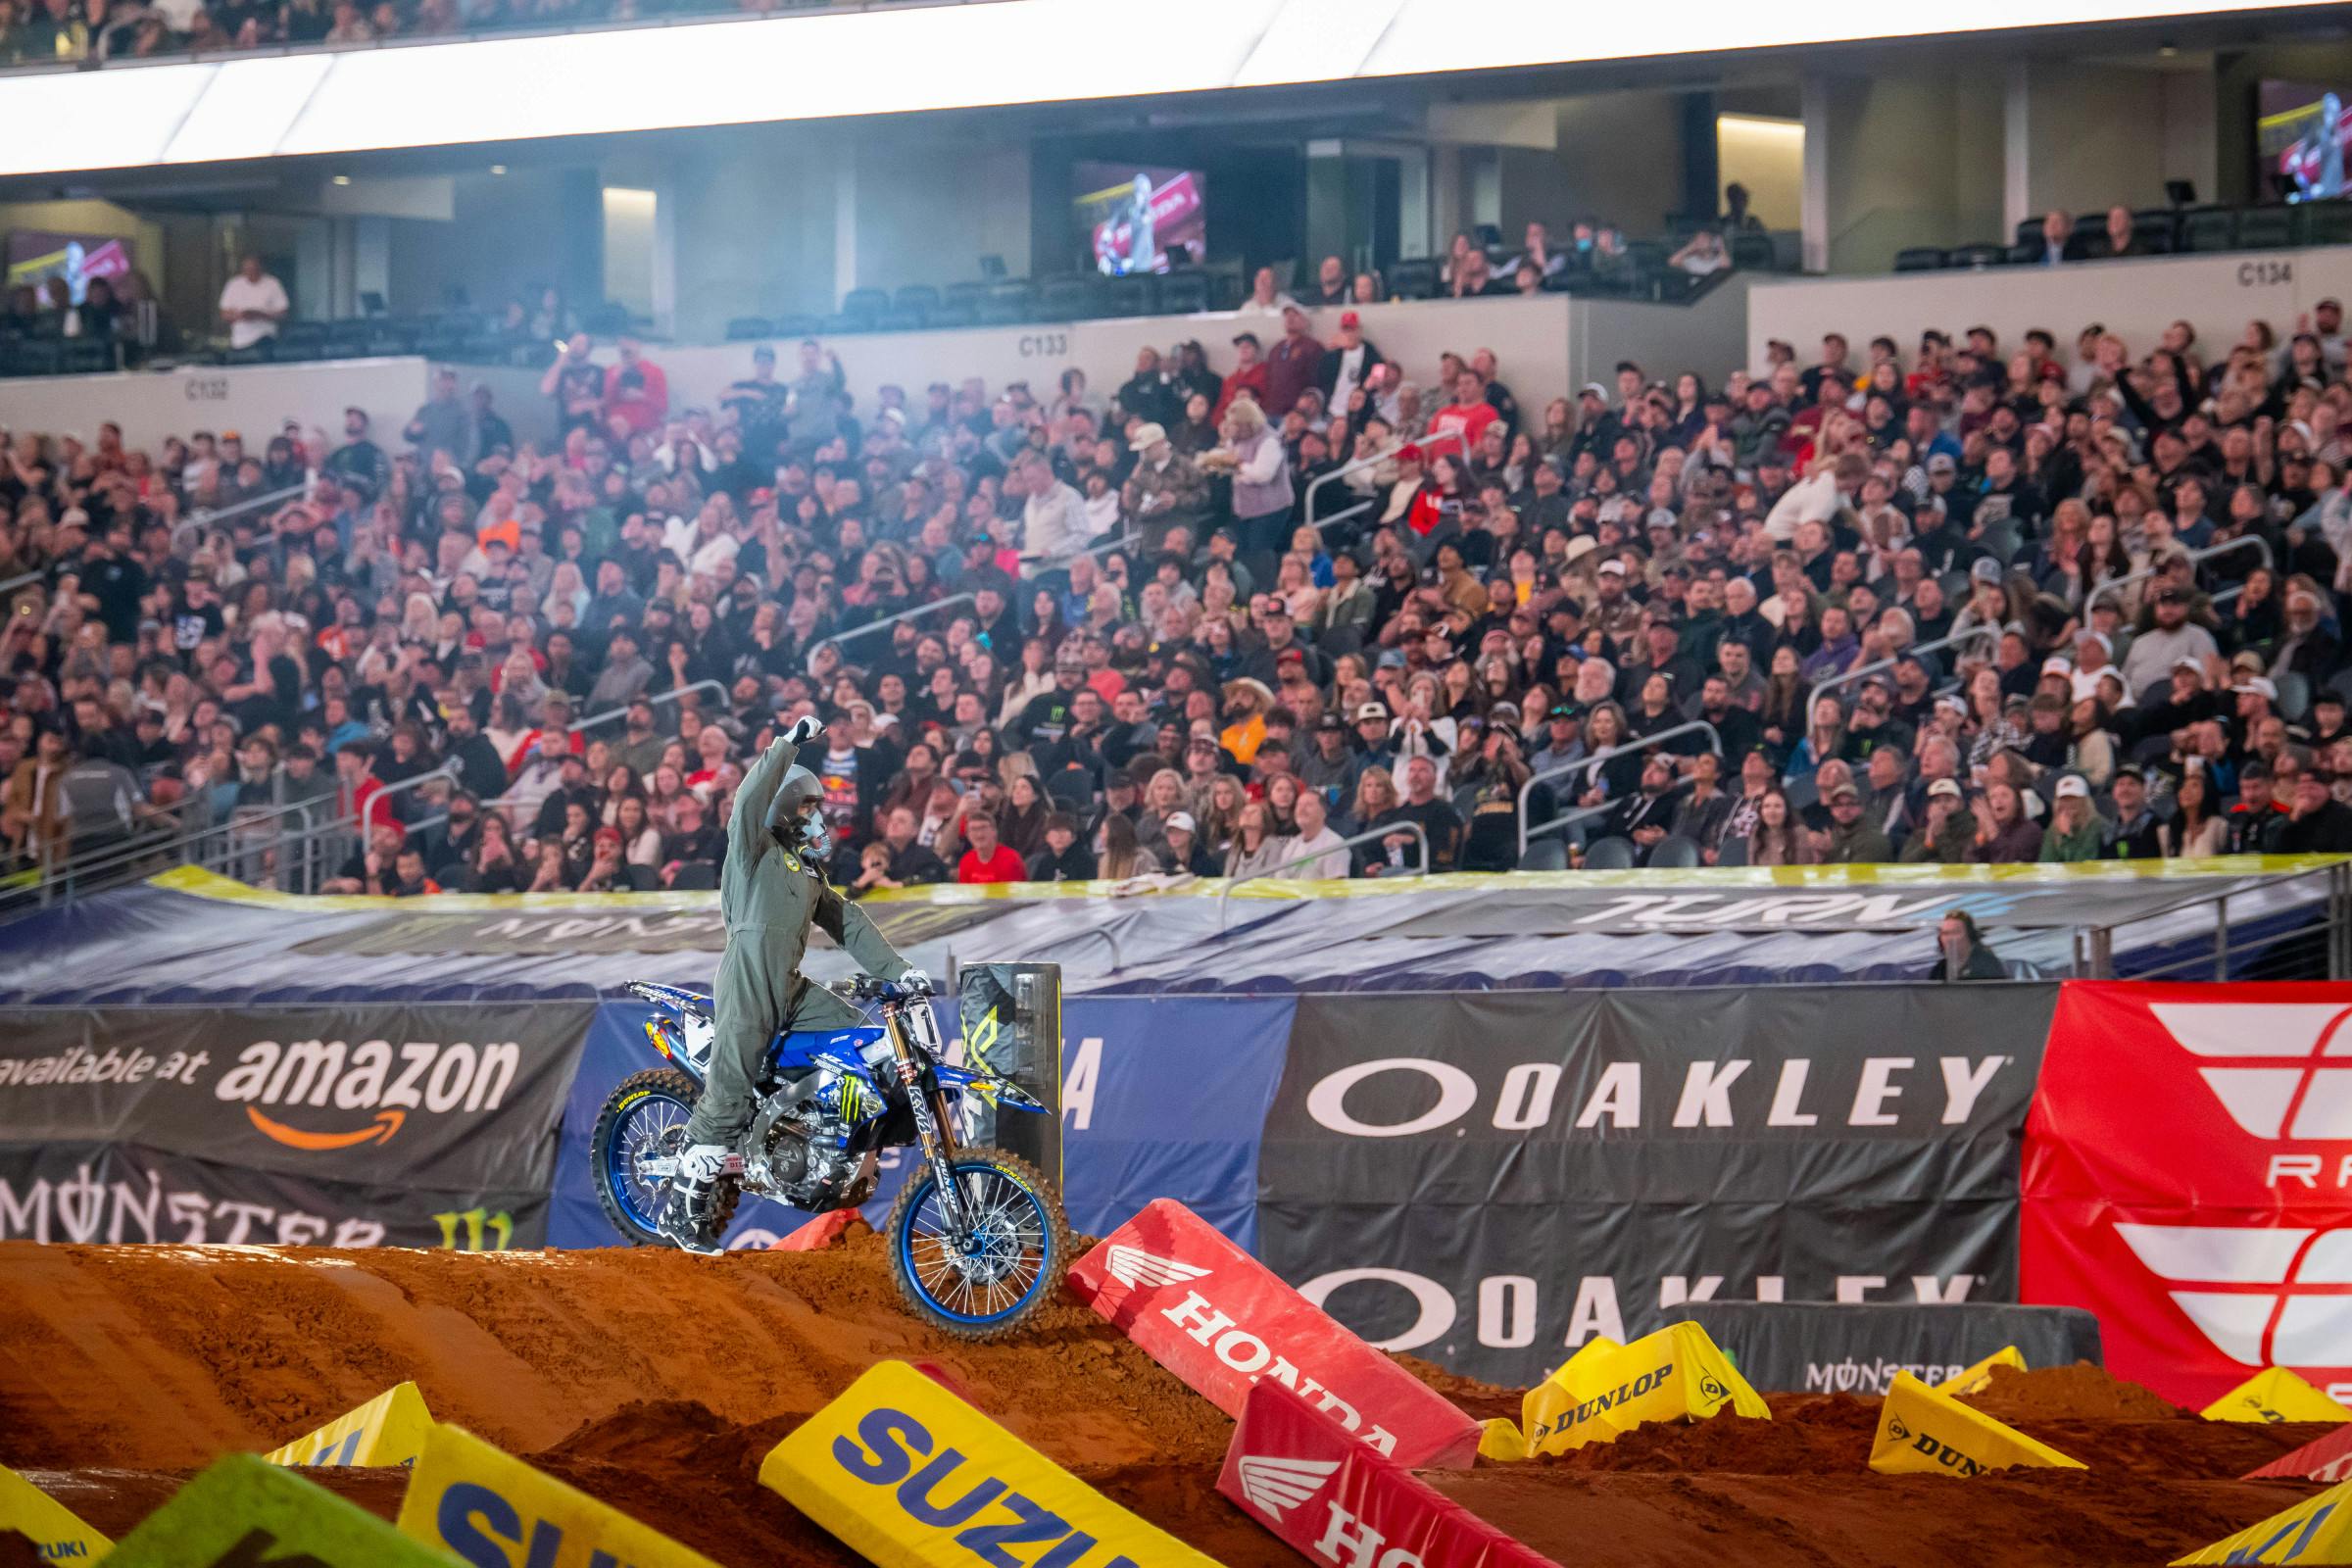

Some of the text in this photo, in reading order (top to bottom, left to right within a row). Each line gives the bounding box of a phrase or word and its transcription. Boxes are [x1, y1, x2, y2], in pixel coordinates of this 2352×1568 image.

[1019, 334, 1067, 358] C133
[0, 1046, 211, 1086] available at
[215, 1040, 520, 1113] amazon
[617, 1090, 651, 1112] DUNLOP
[1492, 1054, 2005, 1131] OAKLEY
[938, 1157, 959, 1214] DUNLOP
[995, 1164, 1033, 1194] DUNLOP
[1554, 1363, 1673, 1435] DUNLOP
[1913, 1433, 1984, 1477] DUN
